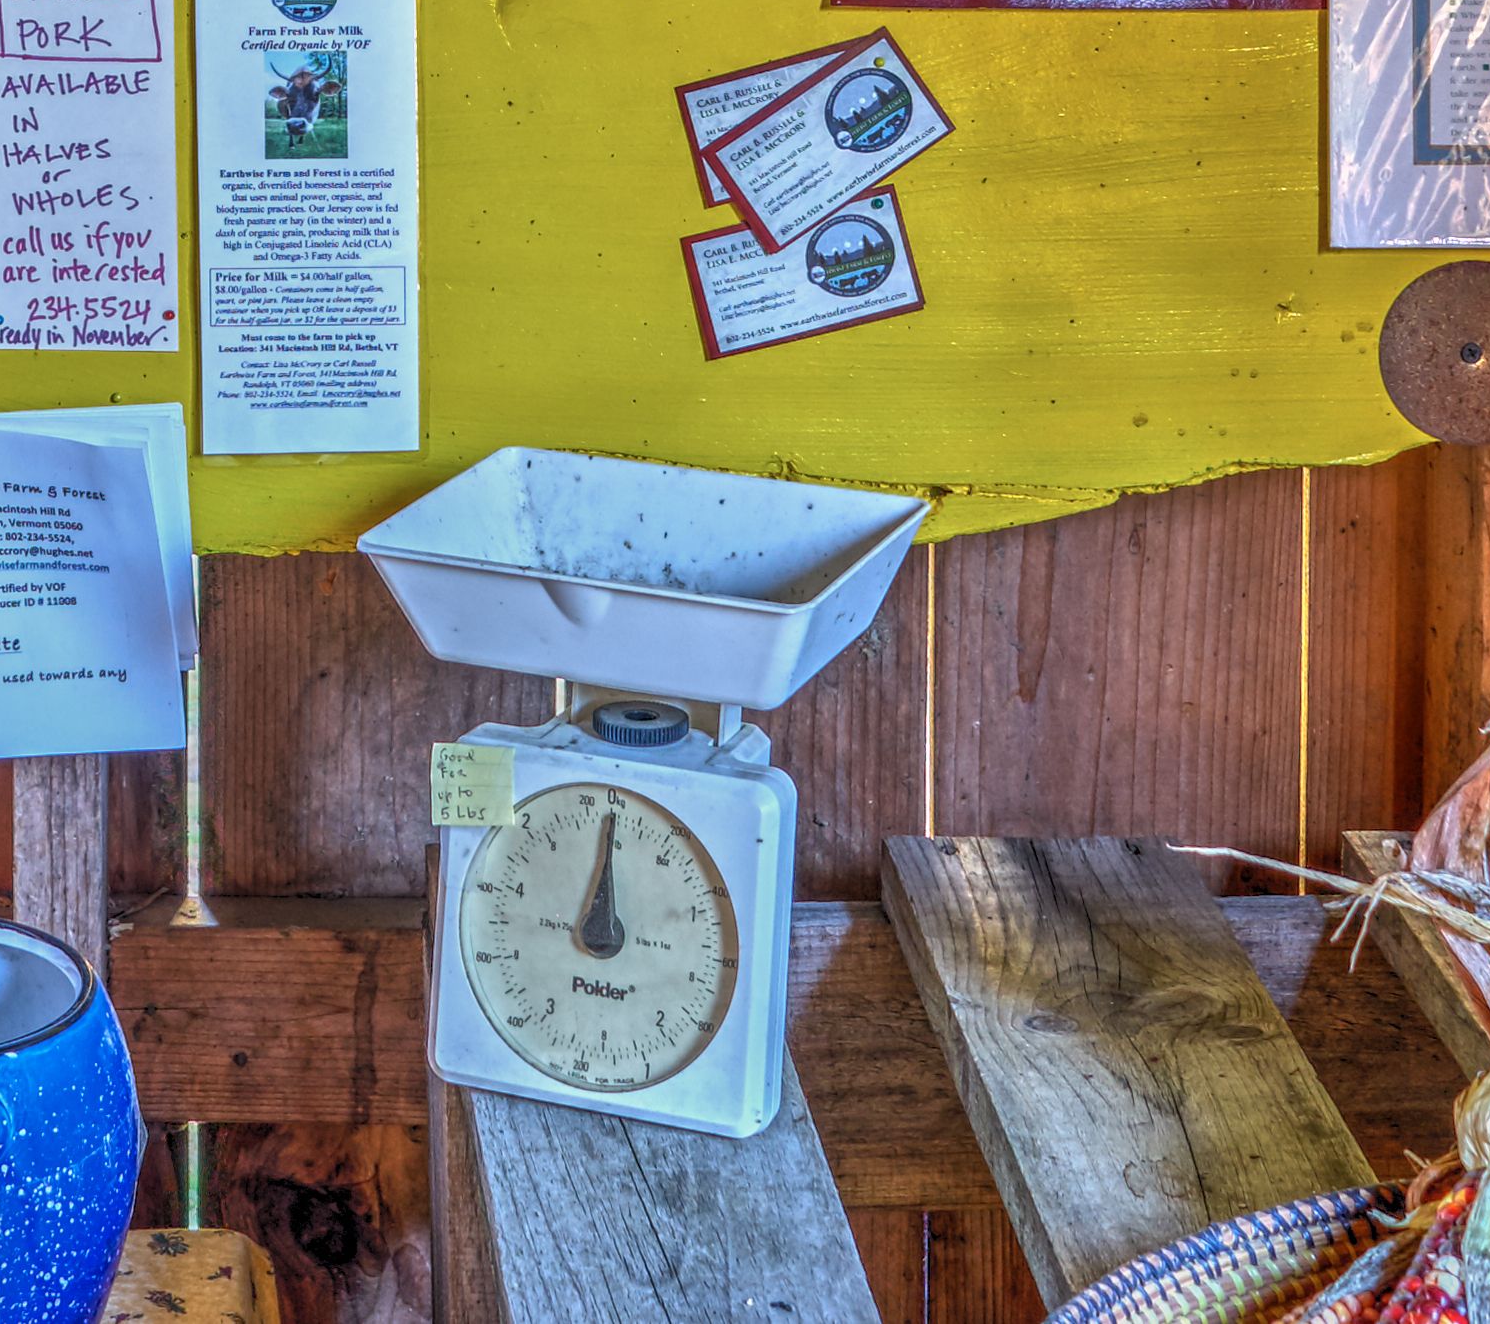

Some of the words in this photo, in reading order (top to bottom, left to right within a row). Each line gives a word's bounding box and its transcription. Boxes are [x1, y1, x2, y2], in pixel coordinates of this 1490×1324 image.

[17, 17, 111, 50] PORK
[247, 26, 277, 37] Farm
[279, 26, 310, 37] Fresh
[312, 26, 335, 37] Raw
[337, 26, 365, 37] Milk
